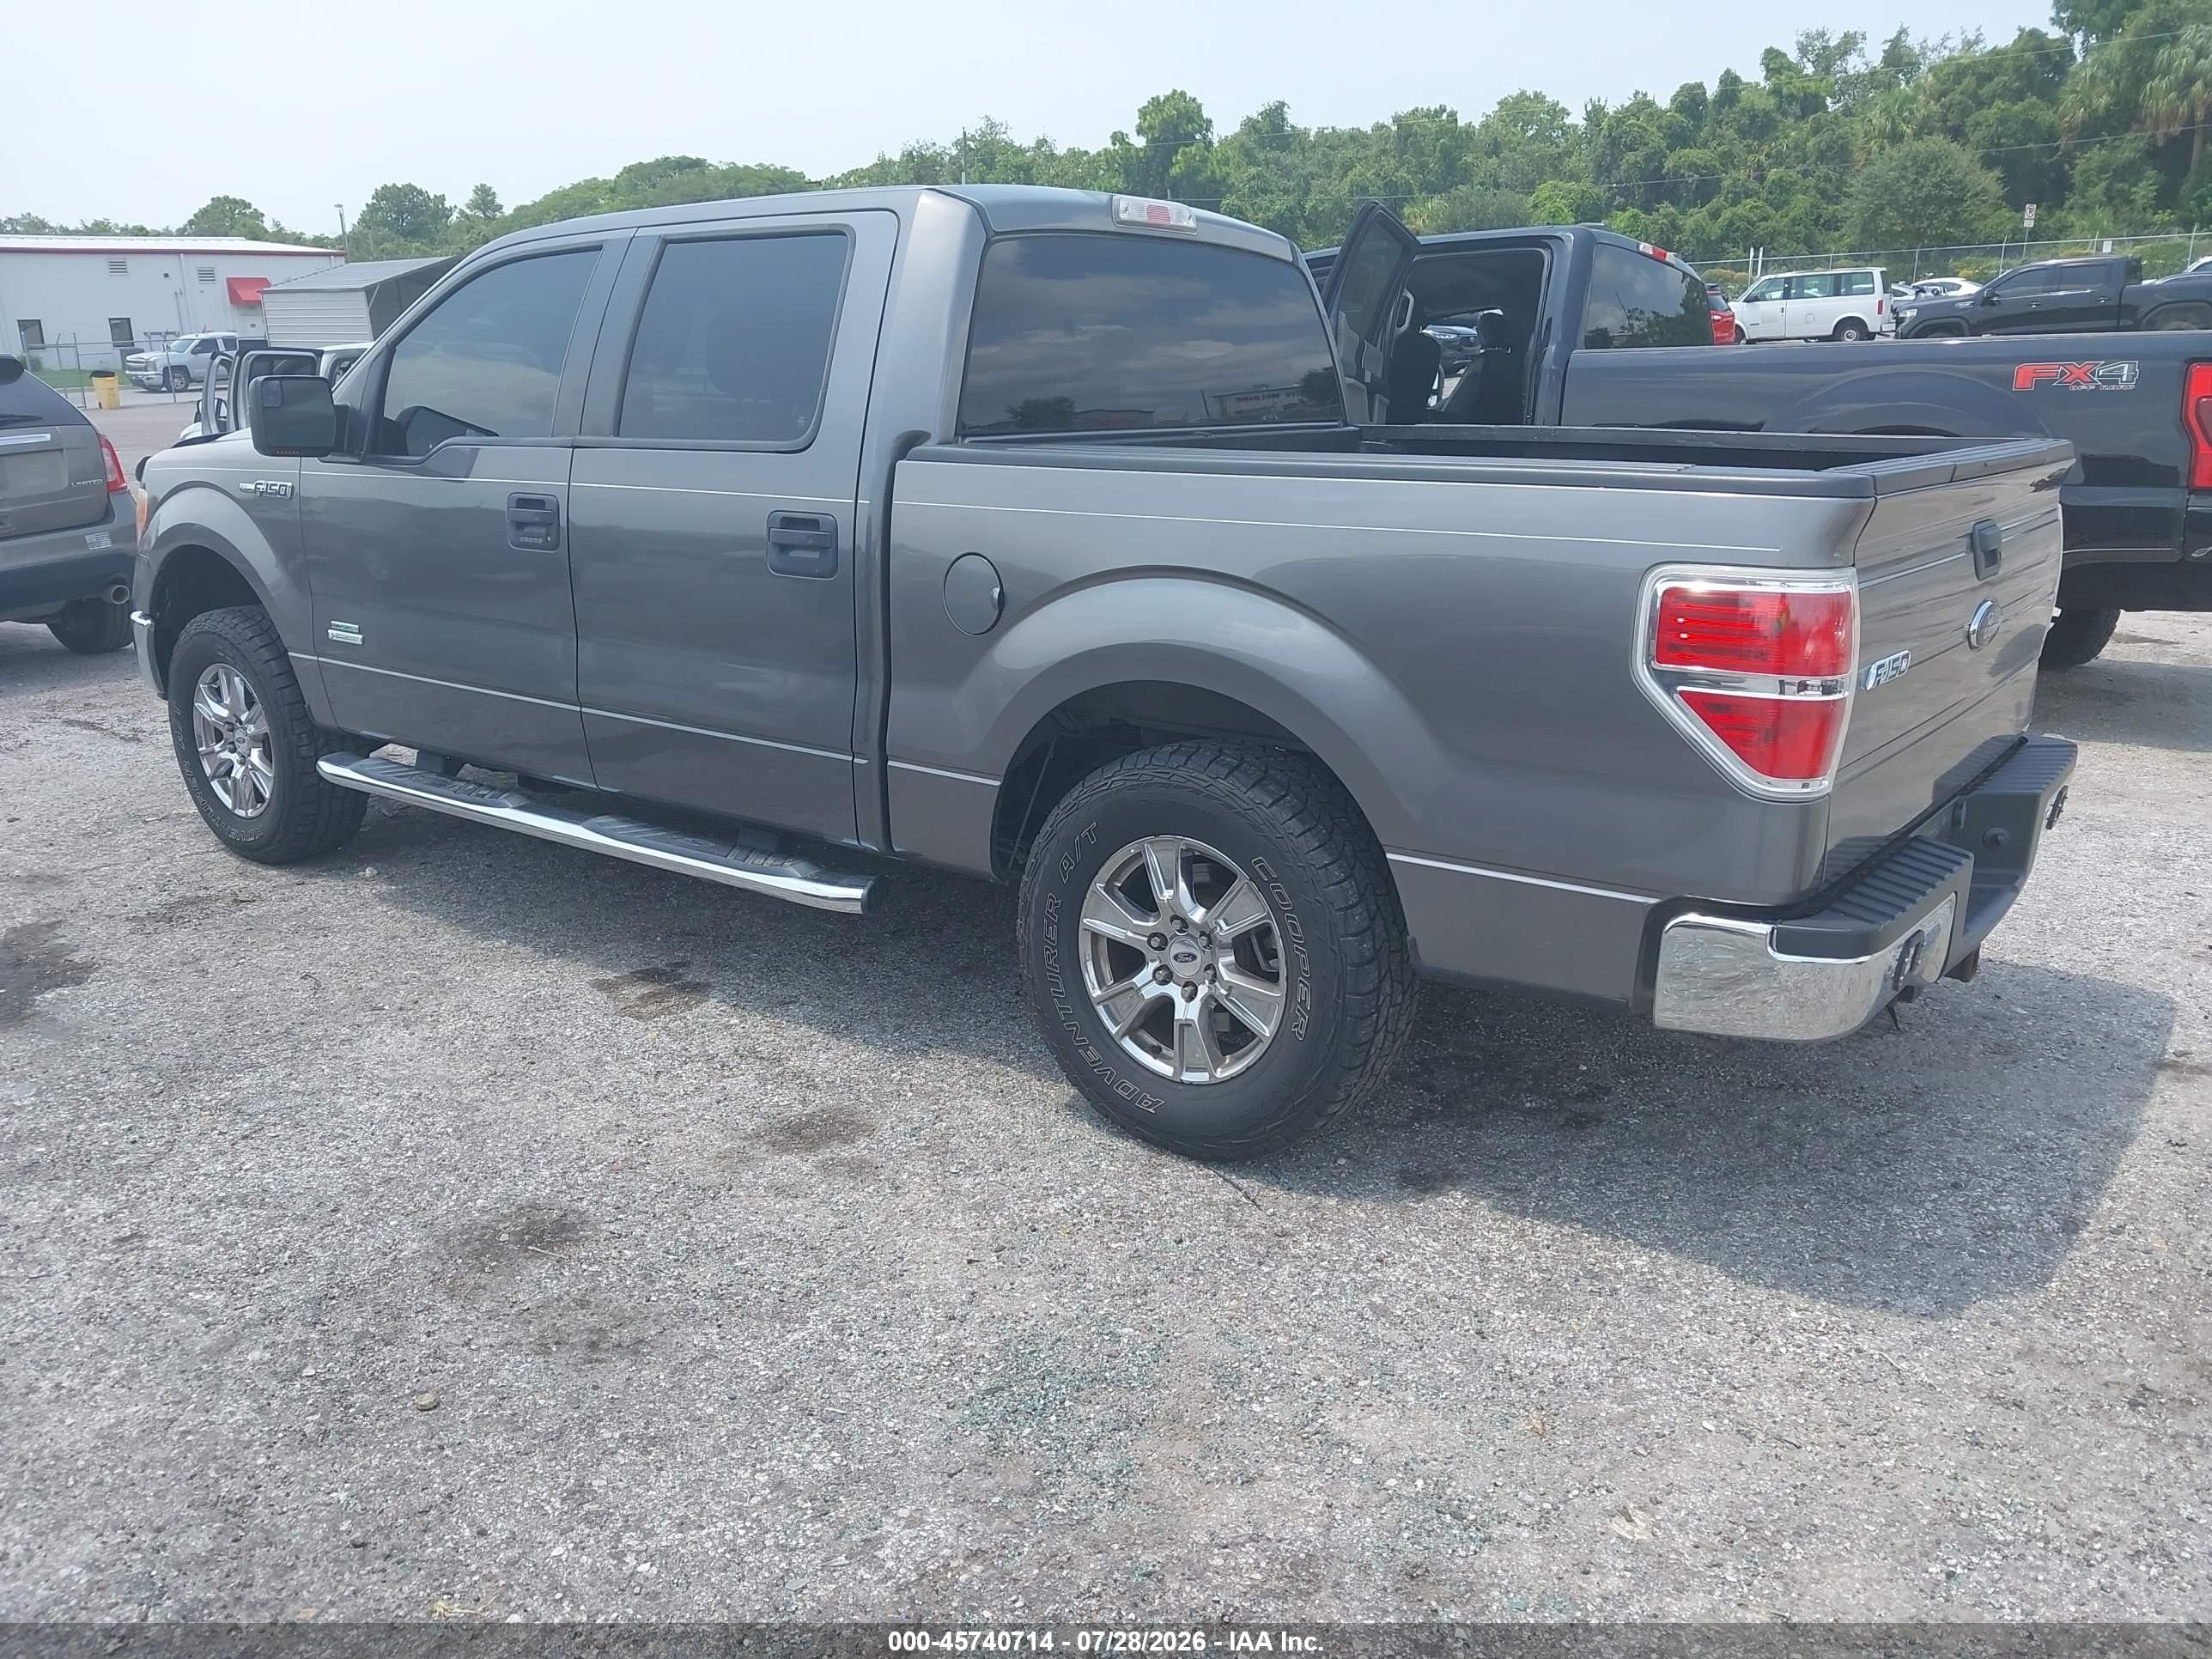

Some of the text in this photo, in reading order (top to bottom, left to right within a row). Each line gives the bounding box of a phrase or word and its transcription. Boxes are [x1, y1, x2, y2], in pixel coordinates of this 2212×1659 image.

[2013, 360, 2140, 391] FX4
[70, 477, 104, 487] LIMITED
[1058, 821, 1100, 885] A/T
[1176, 952, 1194, 962] Ford
[1250, 855, 1313, 1042] COOPER
[1042, 892, 1167, 1114] ADVENTURER
